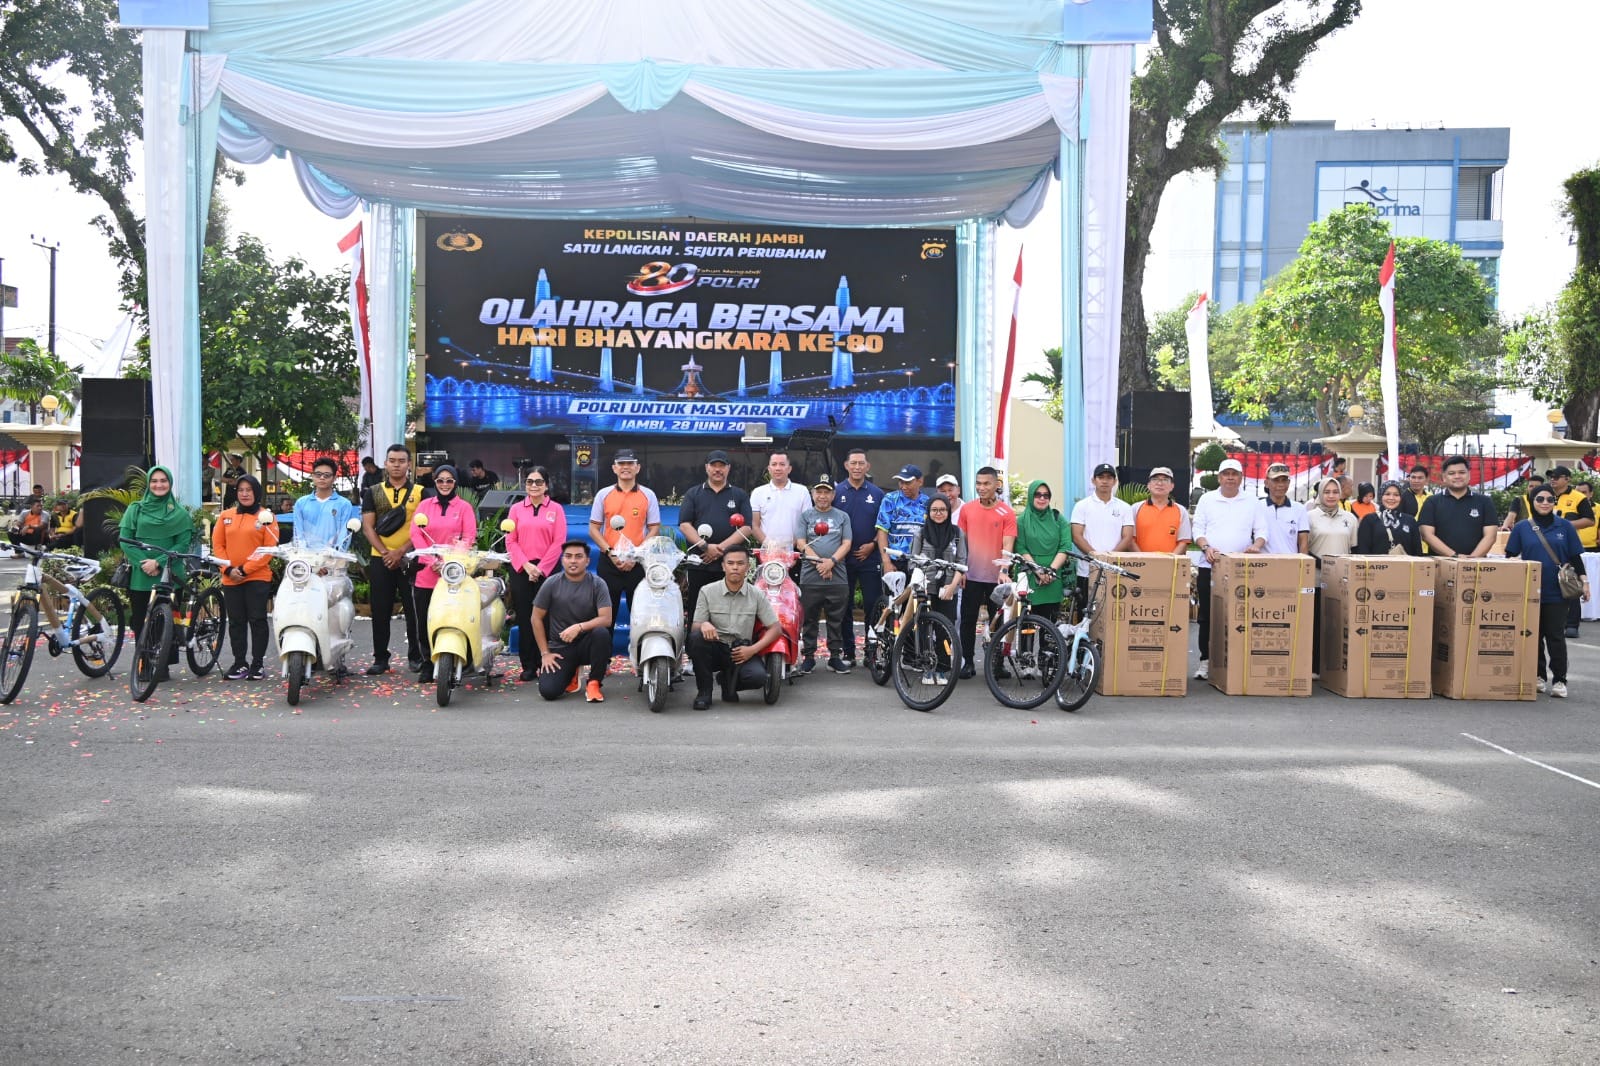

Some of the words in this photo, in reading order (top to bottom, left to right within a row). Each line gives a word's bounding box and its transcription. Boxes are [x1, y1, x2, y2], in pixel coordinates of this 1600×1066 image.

[584, 229, 680, 241] KEPOLISIAN
[684, 231, 751, 243] DAERAH
[755, 233, 804, 244] JAMBI
[562, 243, 601, 254] SATU
[603, 244, 672, 256] LANGKAH
[684, 246, 734, 258] SEJUTA
[737, 247, 826, 259] PERUBAHAN
[697, 277, 760, 289] POLRI
[479, 298, 698, 328] OLAHRAGA
[708, 302, 905, 333] BERSAMA
[497, 327, 566, 347] HARI
[575, 330, 790, 351] BHAYANGKARA
[798, 333, 884, 353] KE-80
[577, 402, 626, 413] POLRI
[629, 402, 688, 415] UNTUK
[691, 404, 805, 416] MASYARAKAT
[620, 419, 667, 431] JAMBI,
[673, 420, 690, 430] 28
[693, 420, 726, 432] JUNI
[1131, 604, 1164, 617] kirei
[1481, 609, 1515, 622] kirei
